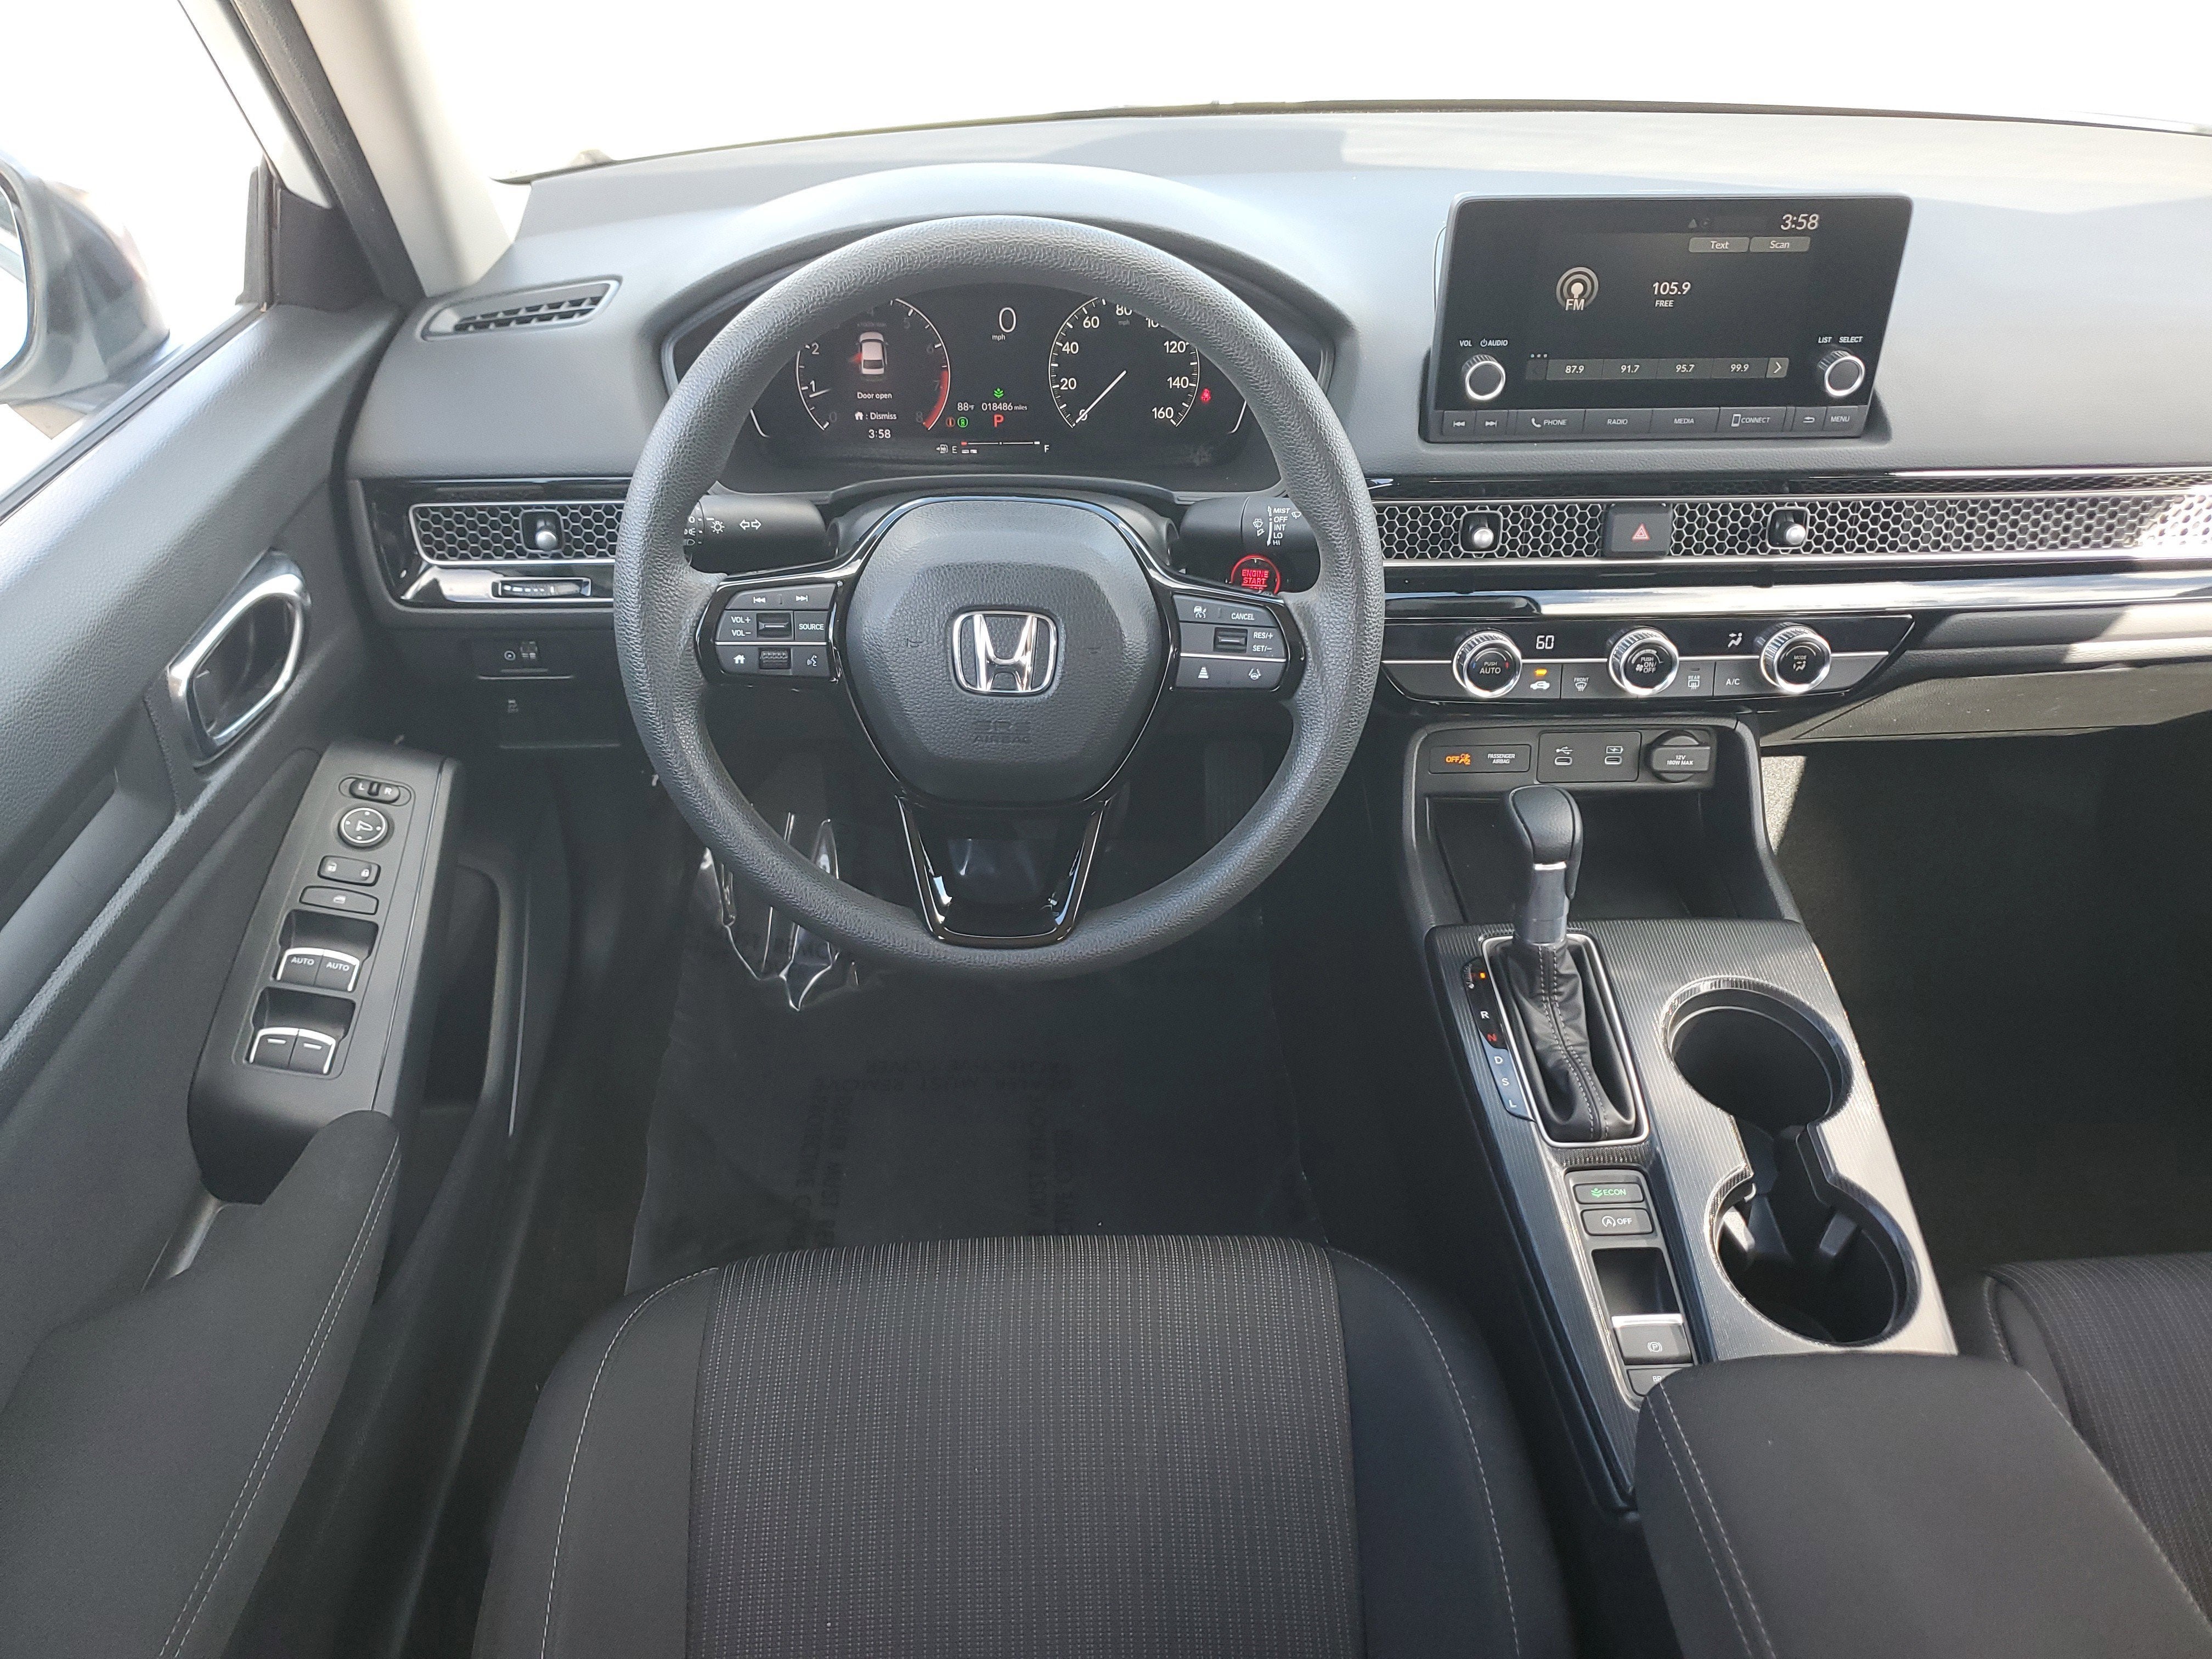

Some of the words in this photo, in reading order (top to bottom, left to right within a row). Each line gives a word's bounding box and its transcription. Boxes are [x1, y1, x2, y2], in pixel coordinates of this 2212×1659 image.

[1780, 213, 1820, 230] 3:58
[1710, 241, 1729, 249] Text
[1769, 241, 1790, 249] Scan
[1652, 281, 1691, 295] 105.9
[1565, 298, 1585, 311] FM
[999, 307, 1016, 332] 0
[1083, 316, 1100, 328] 60
[811, 342, 820, 355] 2
[1062, 341, 1079, 354] 40
[1164, 340, 1186, 353] 120
[1565, 365, 1585, 374] 87.9
[1620, 364, 1640, 374] 91.7
[1675, 364, 1695, 373] 95.7
[1730, 363, 1750, 373] 99.9
[810, 380, 815, 392] 1
[1060, 377, 1077, 390] 20
[1167, 376, 1189, 389] 140
[981, 402, 1013, 411] 018486
[870, 412, 897, 420] Dismiss
[1152, 407, 1174, 419] 160
[994, 414, 1004, 427] P
[868, 428, 891, 439] 3:58
[952, 445, 958, 454] E
[1044, 444, 1050, 453] F
[1242, 569, 1269, 578] ENGINE
[1243, 577, 1267, 585] START
[1536, 635, 1555, 650] 60
[385, 787, 392, 795] R
[290, 957, 314, 966] AUTO
[325, 962, 349, 972] AUTO
